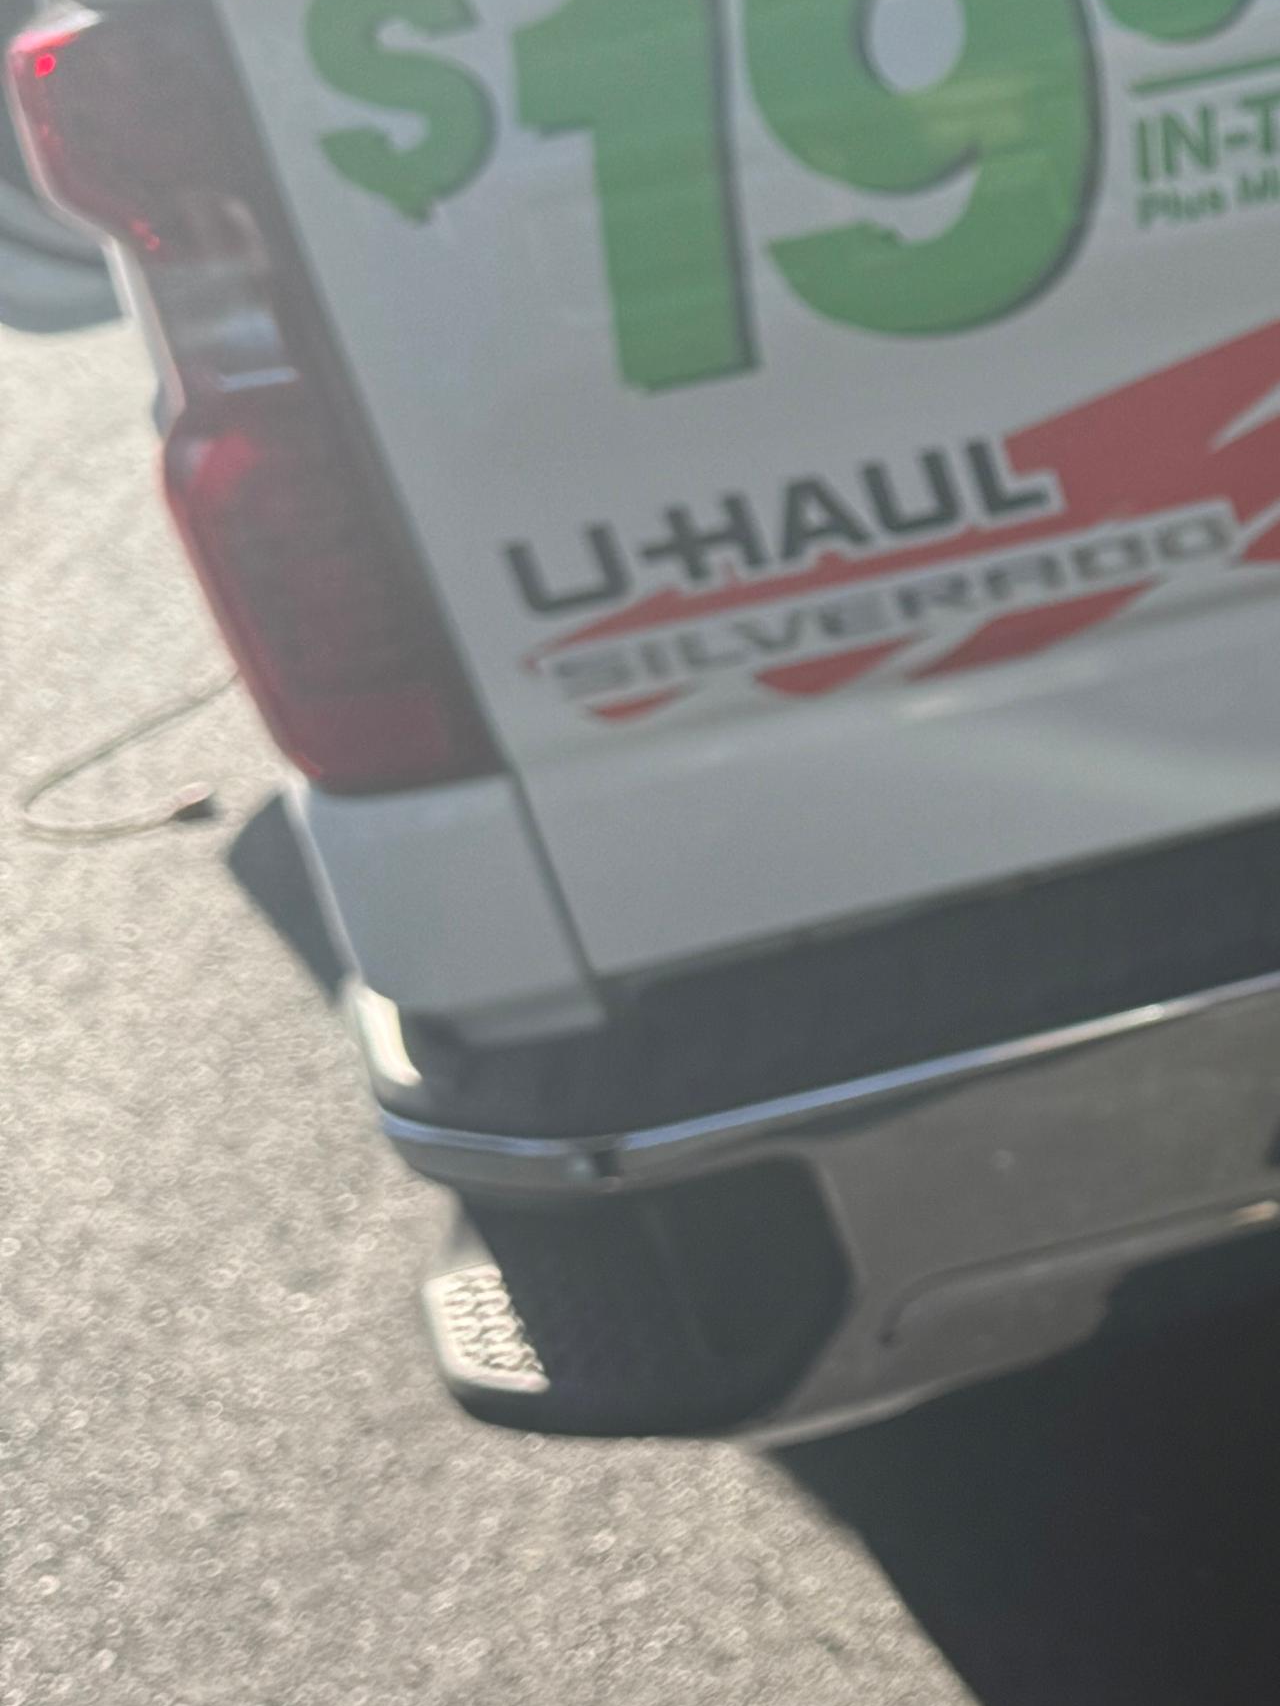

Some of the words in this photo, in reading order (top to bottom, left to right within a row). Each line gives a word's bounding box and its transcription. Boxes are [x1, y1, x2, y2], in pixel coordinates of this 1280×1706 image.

[1135, 183, 1228, 233] Plus
[502, 434, 1053, 617] U-HAUL
[550, 509, 1236, 695] SILVERADO
